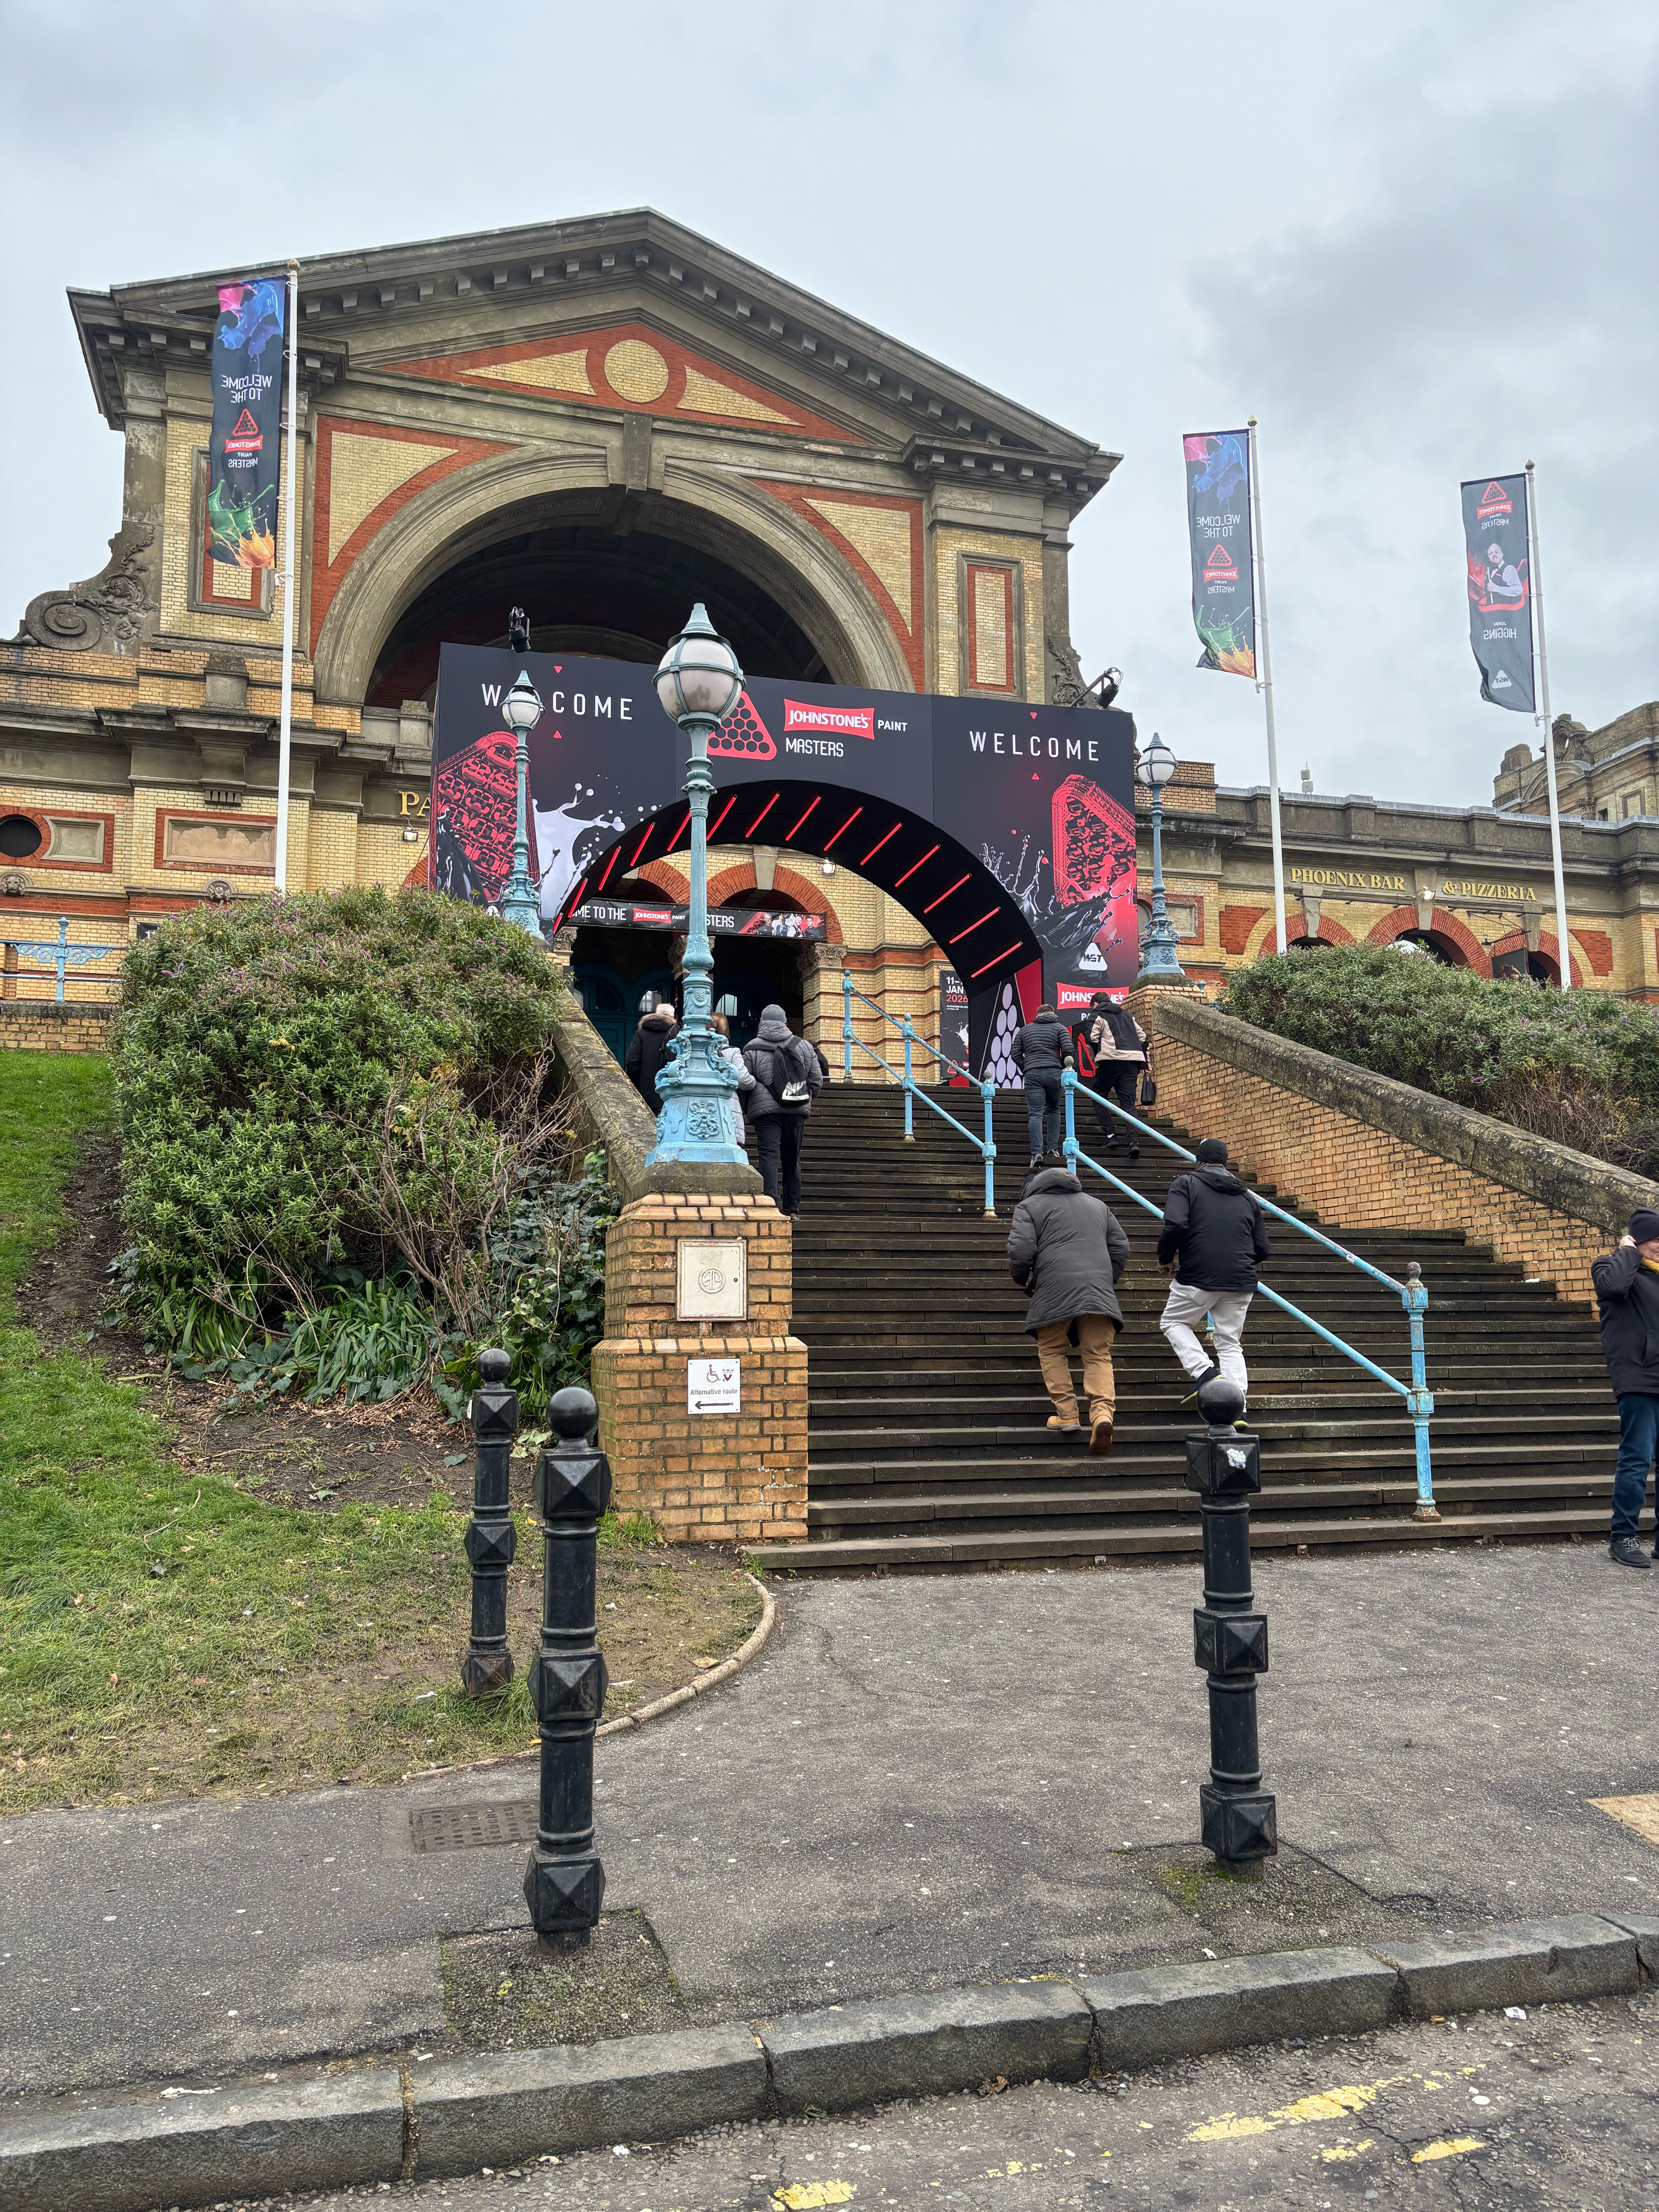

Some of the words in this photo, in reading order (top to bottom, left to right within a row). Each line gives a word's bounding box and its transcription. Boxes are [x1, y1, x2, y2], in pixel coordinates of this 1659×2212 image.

[481, 683, 632, 720] WCOME
[788, 709, 869, 728] JOHNSTONE'S
[878, 720, 908, 732] PAINT
[786, 737, 844, 757] MASTERS
[969, 731, 1099, 761] WELCOME
[1290, 868, 1367, 888] PHOENIX
[1369, 874, 1406, 891] BAR
[1442, 881, 1458, 895] &
[1460, 882, 1537, 901] PIZZERIA
[593, 906, 605, 919] TO
[607, 907, 627, 921] THE
[946, 985, 963, 994] JAN
[946, 994, 968, 1003] 2026
